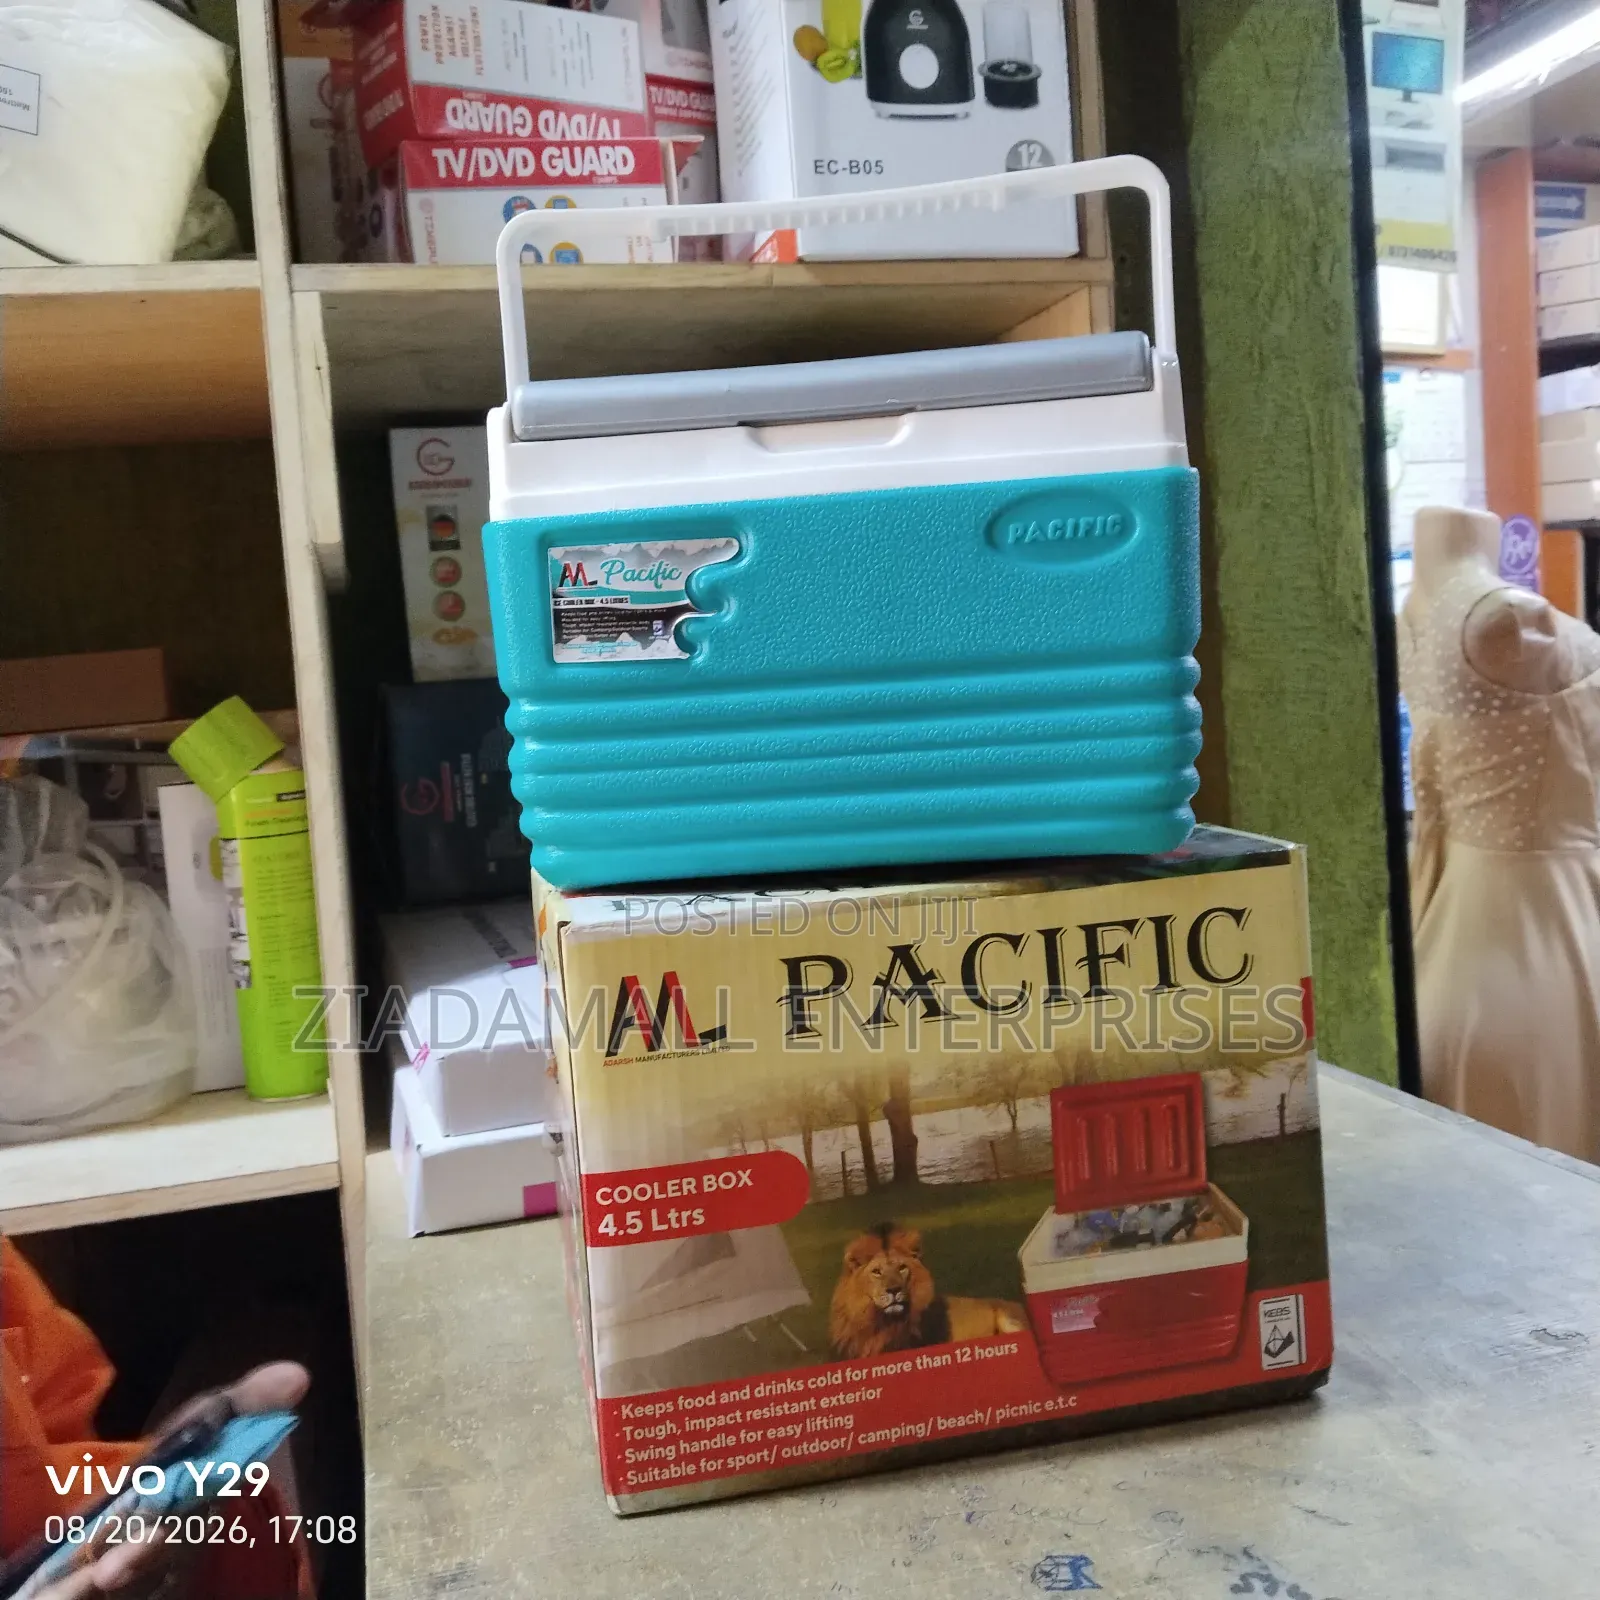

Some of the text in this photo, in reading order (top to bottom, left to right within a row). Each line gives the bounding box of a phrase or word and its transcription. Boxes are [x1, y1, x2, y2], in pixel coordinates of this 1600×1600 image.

[445, 98, 533, 138] GUARD
[432, 146, 636, 181] TV/DVD GUARD
[813, 159, 885, 175] EC-B05
[1018, 143, 1043, 169] 12
[1007, 513, 1123, 545] PACIFIC
[600, 558, 683, 590] Pacific
[776, 907, 1253, 1041] PACIFIC
[595, 1168, 754, 1206] COOLER BOX
[598, 1207, 706, 1237] 4.5 Ltrs
[621, 1342, 1019, 1420] Keeps food and drinks cold for more than 12 hours
[622, 1386, 883, 1442] Tough, impact resistant exterior
[624, 1413, 855, 1465] Swing handle for easy lifting
[626, 1395, 1078, 1487] Suitable for sport/ outdoor/ camping/ beach/ picnic e.t.c
